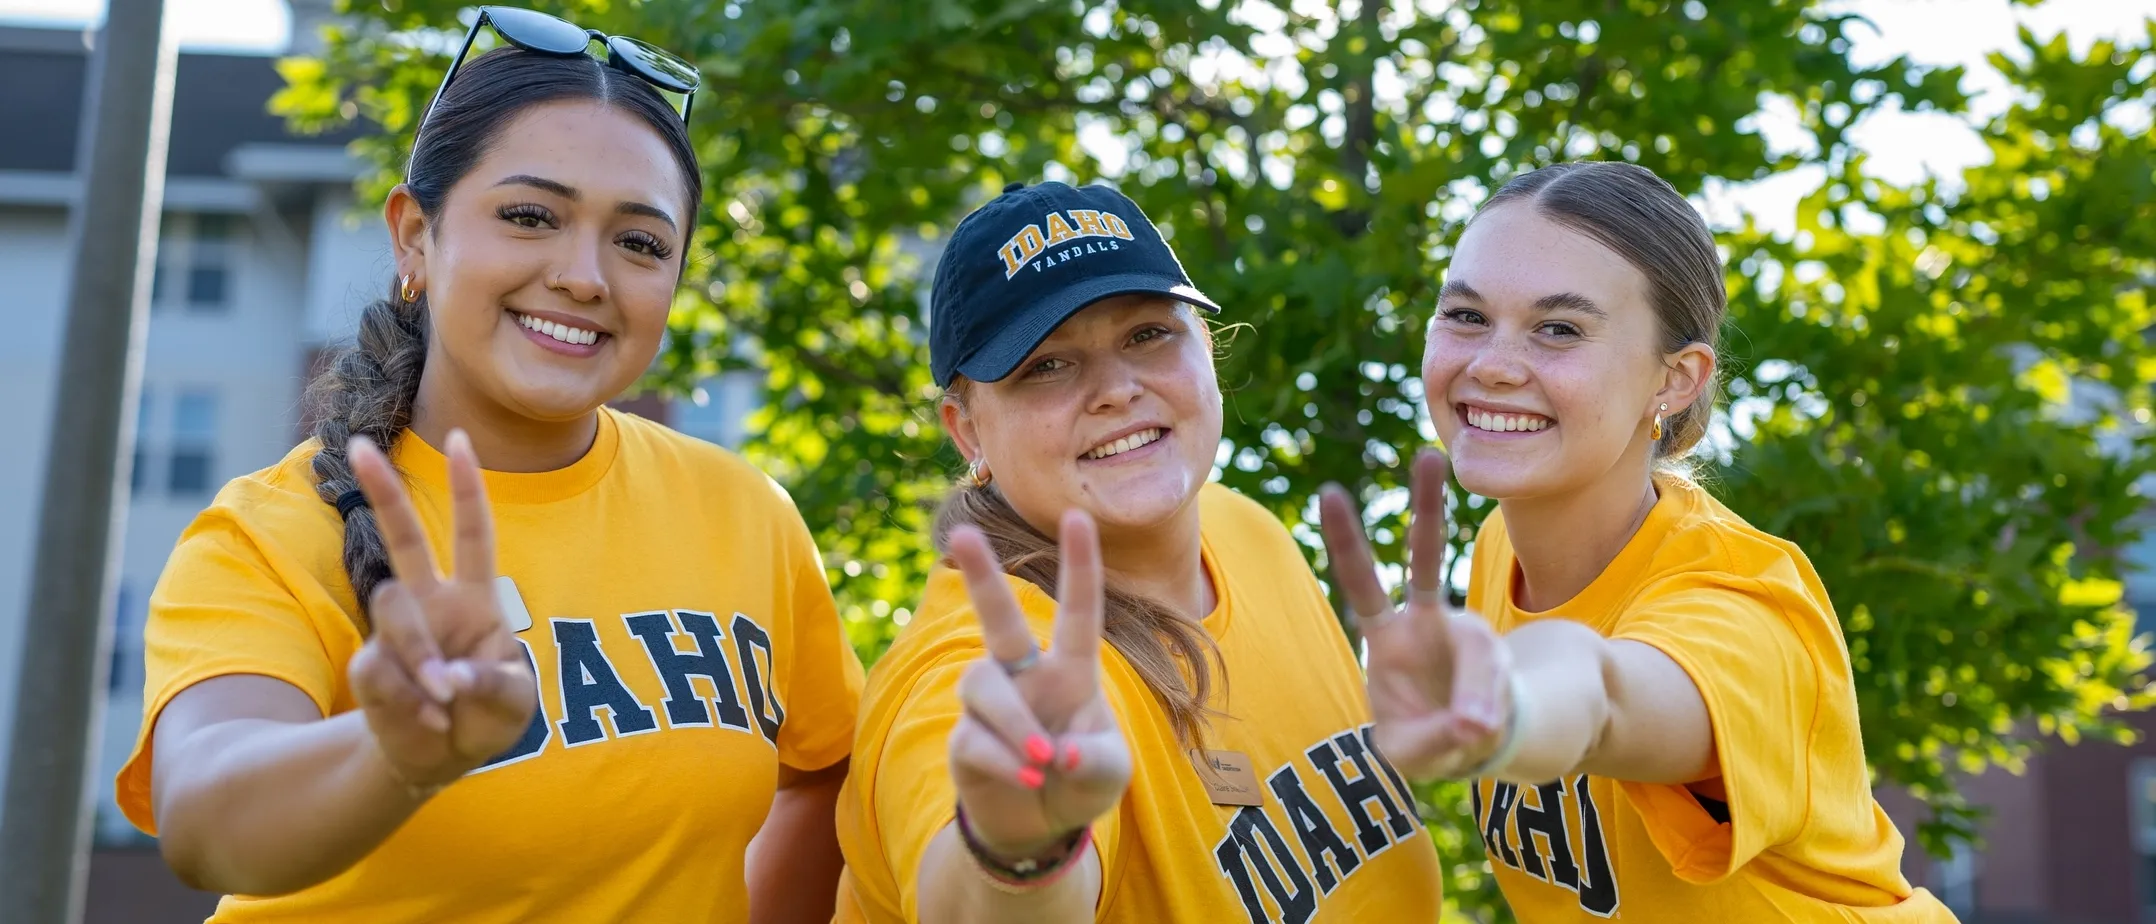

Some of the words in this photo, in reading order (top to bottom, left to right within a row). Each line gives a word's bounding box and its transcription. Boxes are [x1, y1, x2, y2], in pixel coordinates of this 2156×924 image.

[997, 209, 1135, 281] IDAHO
[1032, 240, 1119, 272] VANDALS
[464, 609, 785, 776] AHO
